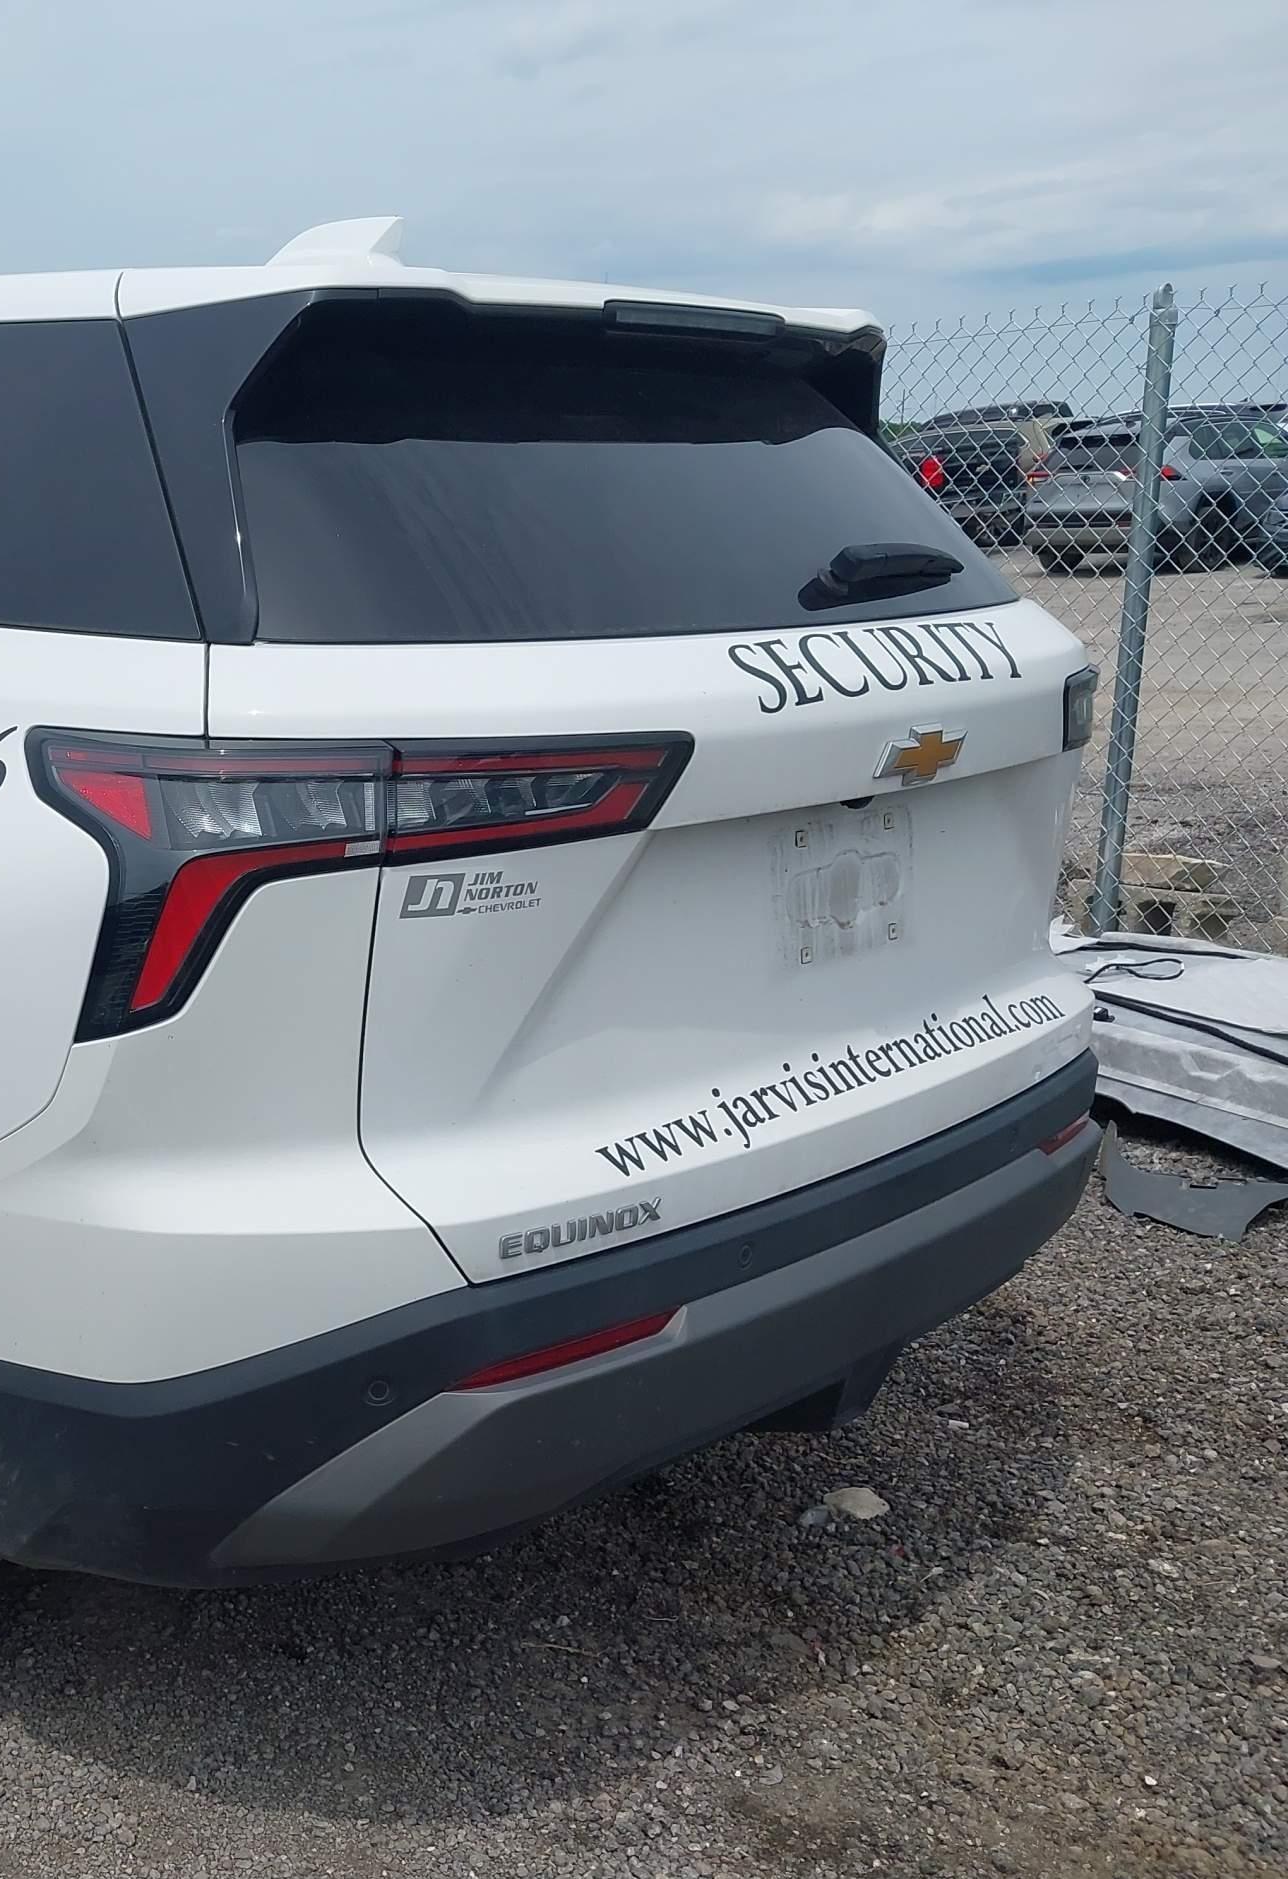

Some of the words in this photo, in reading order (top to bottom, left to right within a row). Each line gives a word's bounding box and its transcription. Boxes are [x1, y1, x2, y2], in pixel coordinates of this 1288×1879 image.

[727, 621, 1022, 714] SECURITY
[464, 881, 538, 902] NORTON
[467, 871, 504, 887] JIM
[478, 898, 542, 914] CHEVROLET
[594, 991, 1065, 1178] www.jarvisinternational.com
[499, 1197, 663, 1260] EQUINOX
